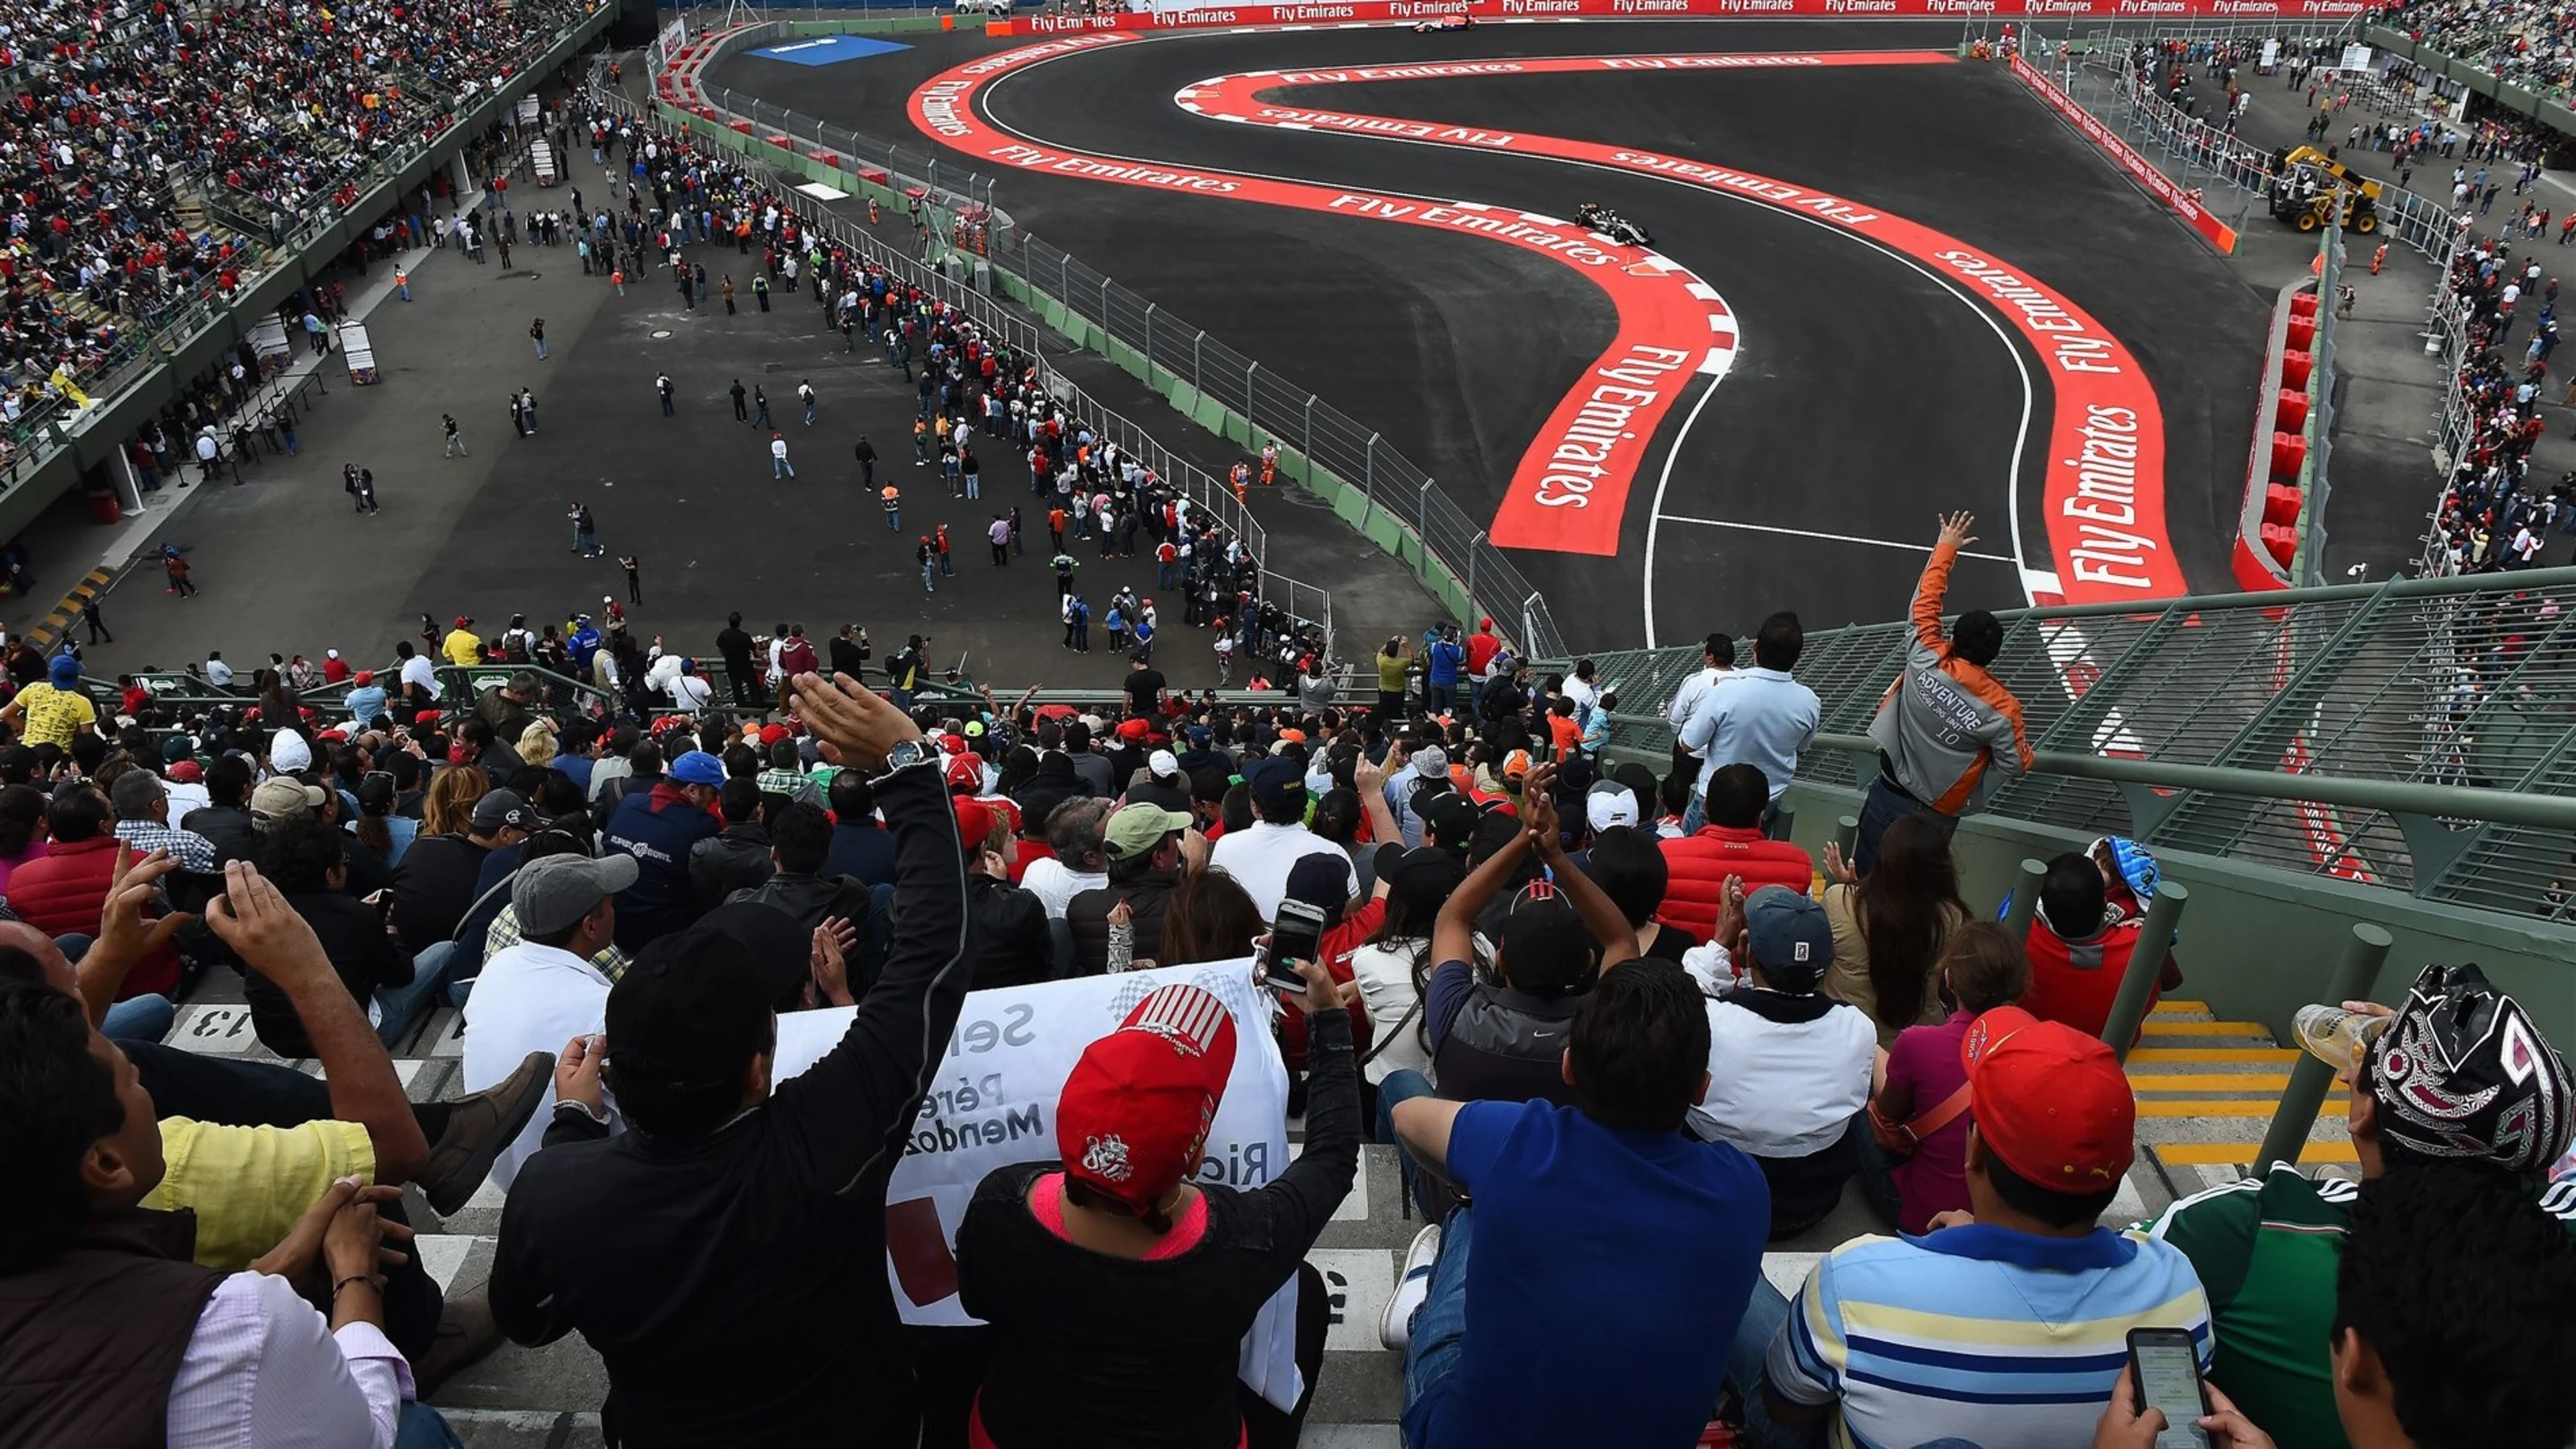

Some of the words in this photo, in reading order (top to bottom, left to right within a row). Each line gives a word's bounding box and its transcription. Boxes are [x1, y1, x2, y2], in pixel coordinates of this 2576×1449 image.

[1273, 6, 1295, 22] Fly
[1298, 5, 1354, 19] Emirates
[1390, 2, 1411, 17] Fly
[1414, 1, 1468, 14] Emirates
[1503, 0, 1524, 14] Fly
[1526, 0, 1579, 12] Emirates
[1614, 0, 1634, 14] Fly
[1637, 0, 1689, 10] Emirates
[1721, 0, 1740, 13] Fly
[1743, 0, 1794, 10] Emirates
[1826, 0, 1845, 13] Fly
[1846, 0, 1896, 10] Emirates
[1927, 0, 1945, 13] Fly
[1948, 0, 1995, 10] Emirates
[2025, 0, 2044, 14] Fly
[2045, 0, 2091, 11] Emirates
[2120, 1, 2139, 14] Fly
[2140, 1, 2185, 12] Emirates
[2214, 1, 2231, 14] Fly
[2232, 1, 2276, 12] Emirates
[2303, 1, 2320, 14] Fly
[2321, 1, 2363, 12] Emirates
[1032, 16, 1054, 32] Fly
[1154, 11, 1176, 27] Fly
[1179, 10, 1236, 24] Emirates
[1598, 58, 1668, 69] Fly
[1669, 53, 1822, 67] Emirates
[1284, 70, 1353, 83] Fly
[1354, 62, 1524, 81] Emirates
[1256, 107, 1439, 138] Emirates
[1437, 124, 1515, 147] Fly
[988, 143, 1056, 167] Fly
[1051, 156, 1243, 193] Emirates
[1611, 151, 1802, 200] Emirates
[1796, 197, 1879, 225] Fly
[1328, 193, 1416, 218] Fly
[1416, 206, 1620, 267] Emirates
[1934, 250, 2084, 332] Emirates
[2053, 334, 2122, 374] Fly
[1598, 344, 1689, 386] Fly
[1534, 384, 1659, 508] Emirates
[2063, 403, 2137, 525] Emirates
[2069, 525, 2157, 588] Fly
[1917, 671, 1982, 730] ADVENTURE
[1935, 727, 1960, 745] 10
[192, 1011, 250, 1038] 13
